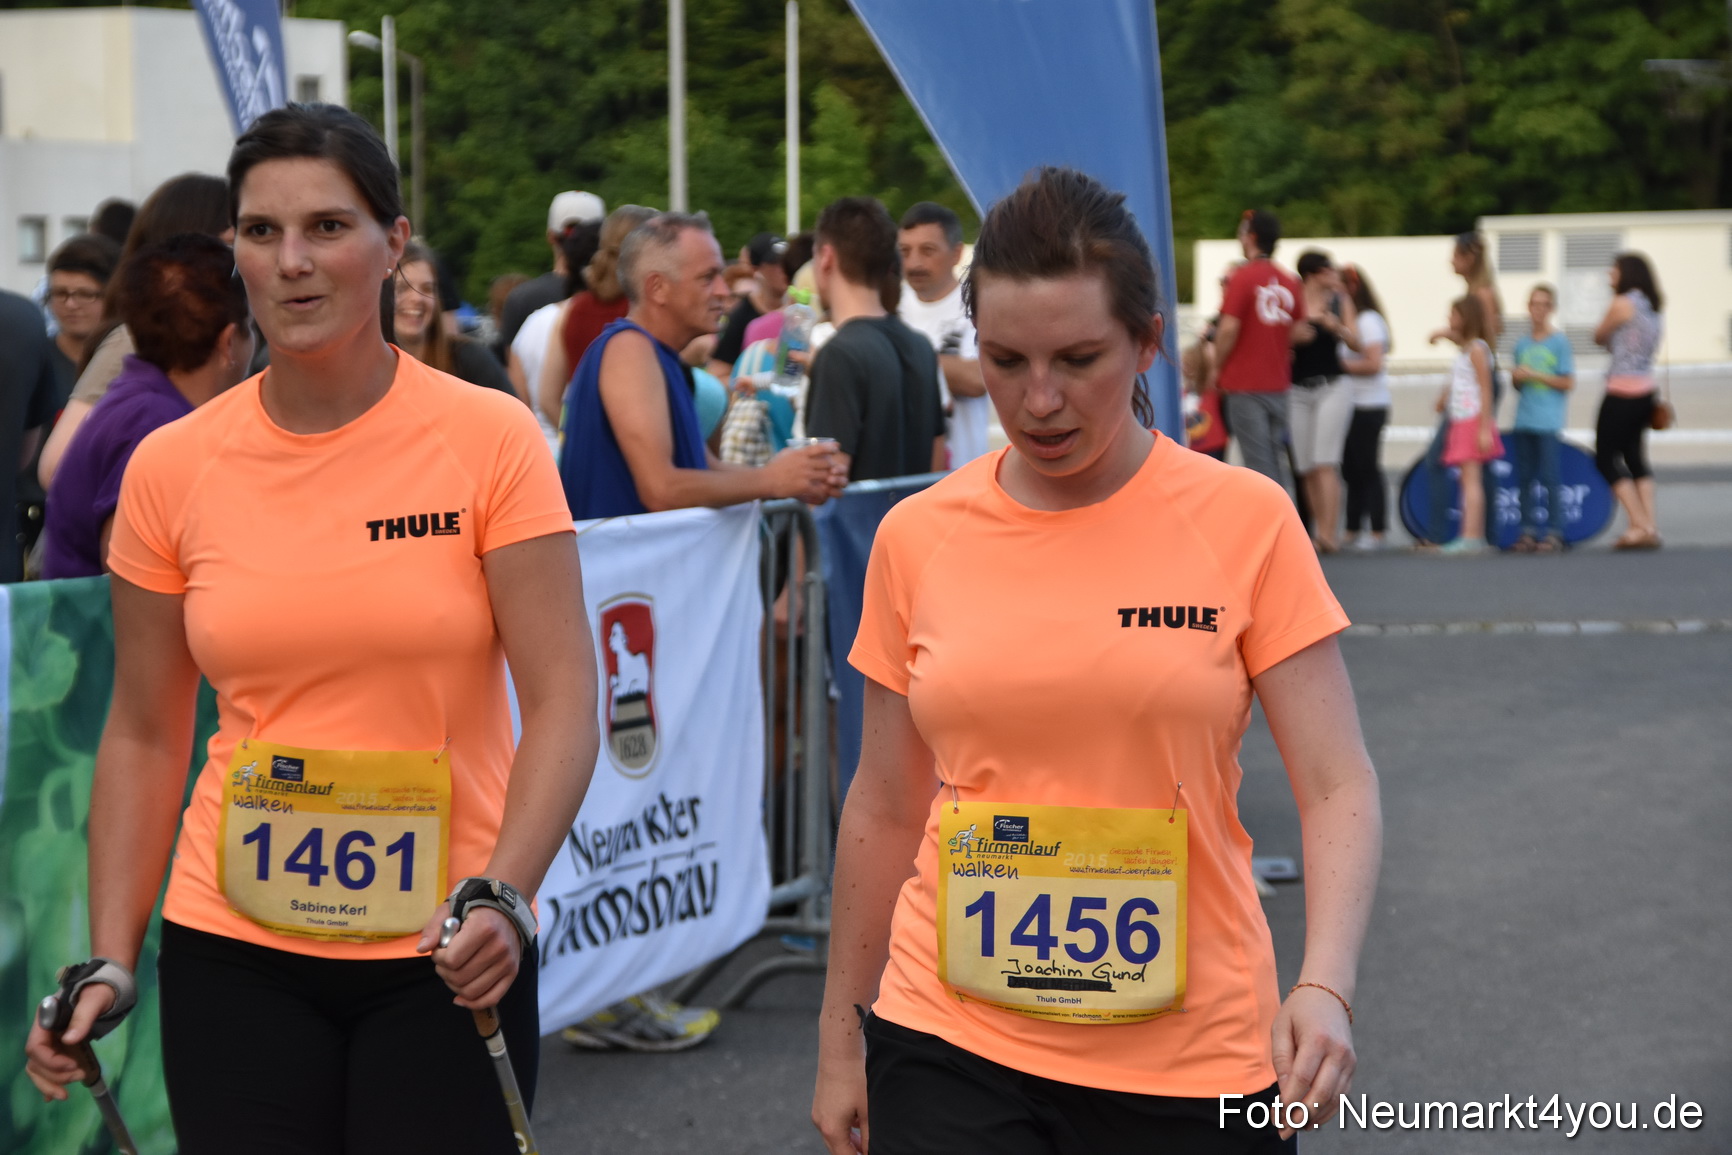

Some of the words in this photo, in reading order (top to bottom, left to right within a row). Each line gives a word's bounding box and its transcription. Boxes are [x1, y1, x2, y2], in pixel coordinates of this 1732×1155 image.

[366, 511, 460, 541] THULE
[1117, 605, 1218, 632] THULE
[1191, 622, 1215, 631] SWEDEN
[619, 733, 647, 761] 1628
[256, 774, 335, 796] firmenlauf
[233, 794, 294, 814] walken
[999, 822, 1024, 830] Fischer
[977, 837, 1062, 856] firmenlauf
[242, 822, 415, 892] 1461
[1063, 852, 1108, 867] 2015
[952, 860, 1019, 880] walken
[290, 899, 336, 915] Sabine
[339, 903, 367, 916] Kerl
[305, 917, 325, 926] Thule
[965, 890, 1161, 965] 1456
[1001, 959, 1083, 977] Joachim
[1092, 962, 1147, 983] Gund
[1036, 995, 1057, 1003] Thule
[1058, 996, 1082, 1005] GmbH
